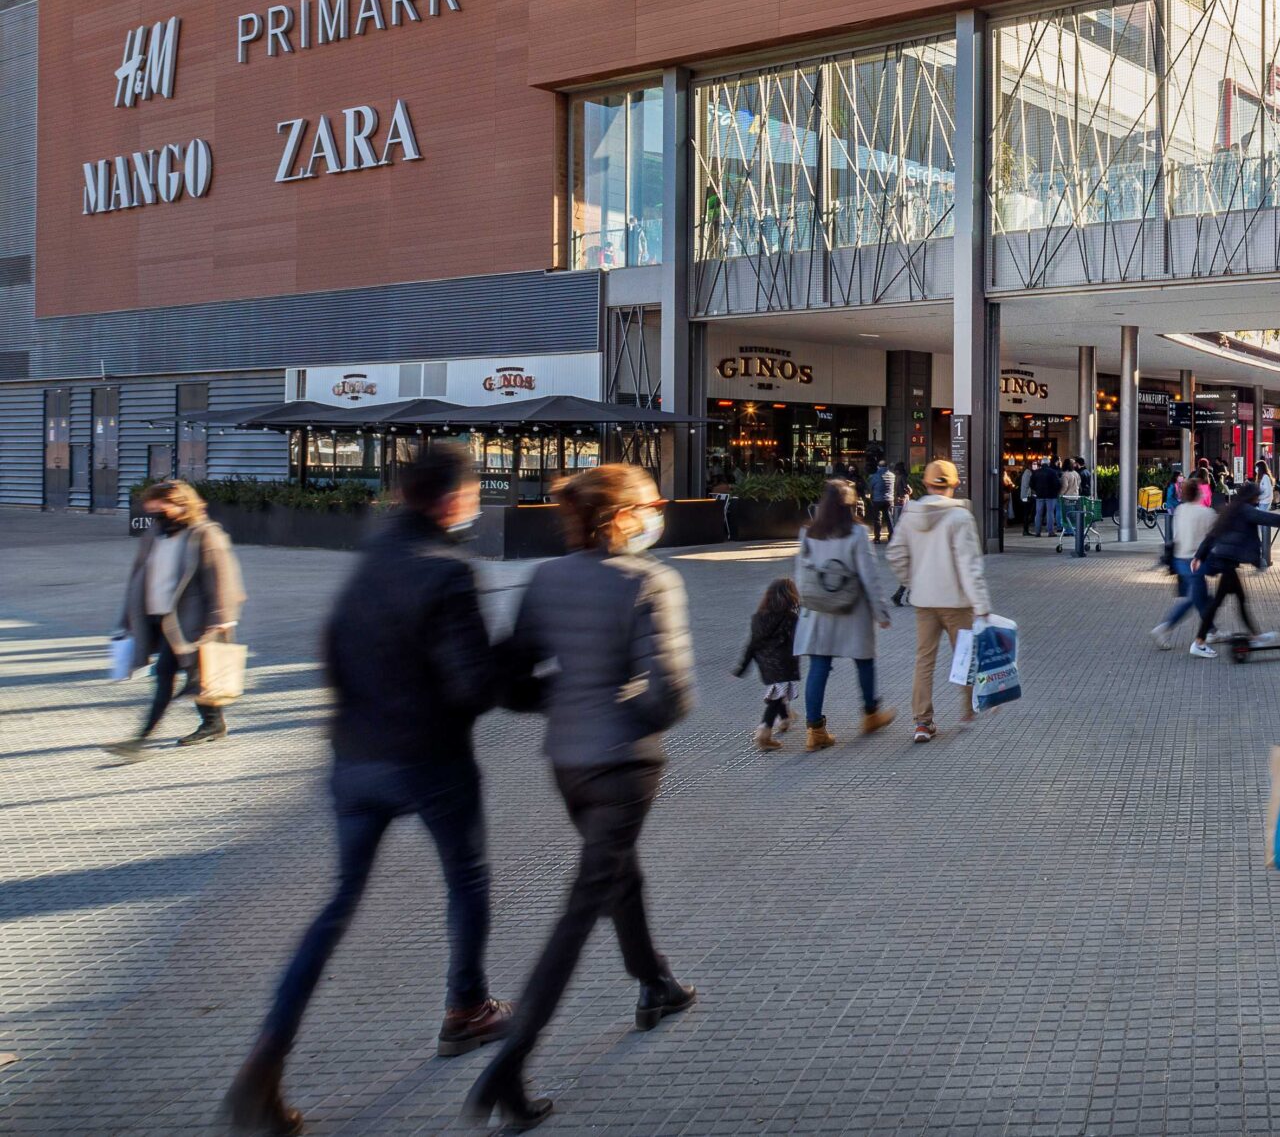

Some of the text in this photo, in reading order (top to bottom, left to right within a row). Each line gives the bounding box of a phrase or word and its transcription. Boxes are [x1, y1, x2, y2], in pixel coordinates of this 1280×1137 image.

[114, 16, 180, 108] H&M
[274, 98, 423, 183] ZARA
[82, 137, 212, 215] MANGO
[716, 357, 813, 384] GINOS
[1000, 377, 1048, 399] INOS
[954, 422, 961, 436] 1
[131, 517, 153, 529] GIN
